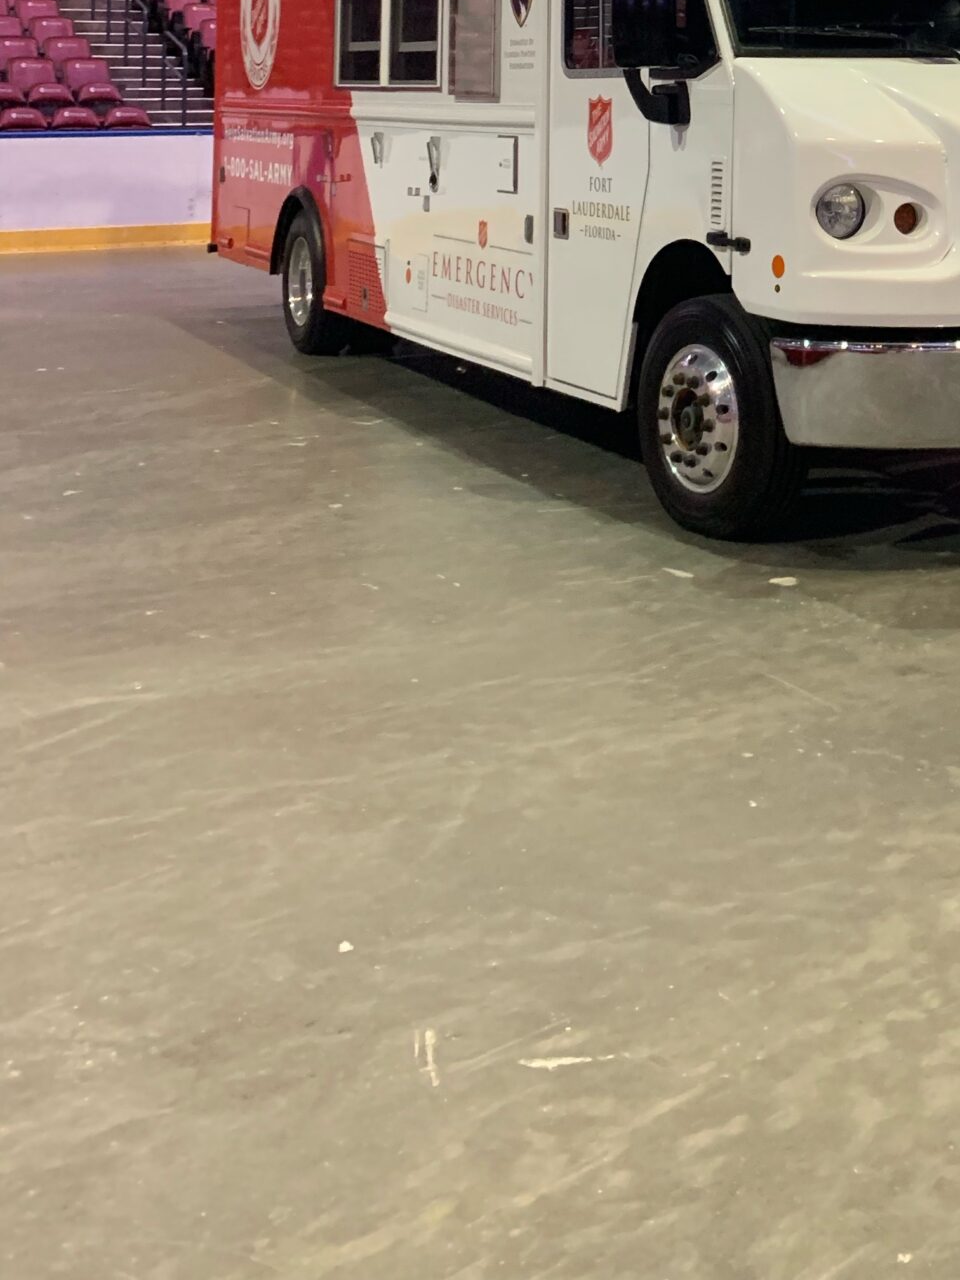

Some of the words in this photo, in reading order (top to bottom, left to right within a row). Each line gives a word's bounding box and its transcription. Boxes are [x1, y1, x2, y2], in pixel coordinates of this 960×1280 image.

[223, 156, 293, 186] 1-800-SAL-ARMY
[589, 176, 613, 193] FORT
[572, 200, 631, 222] LAUDERDALE
[447, 292, 481, 315] DISASTER
[482, 302, 518, 326] SERVICES
